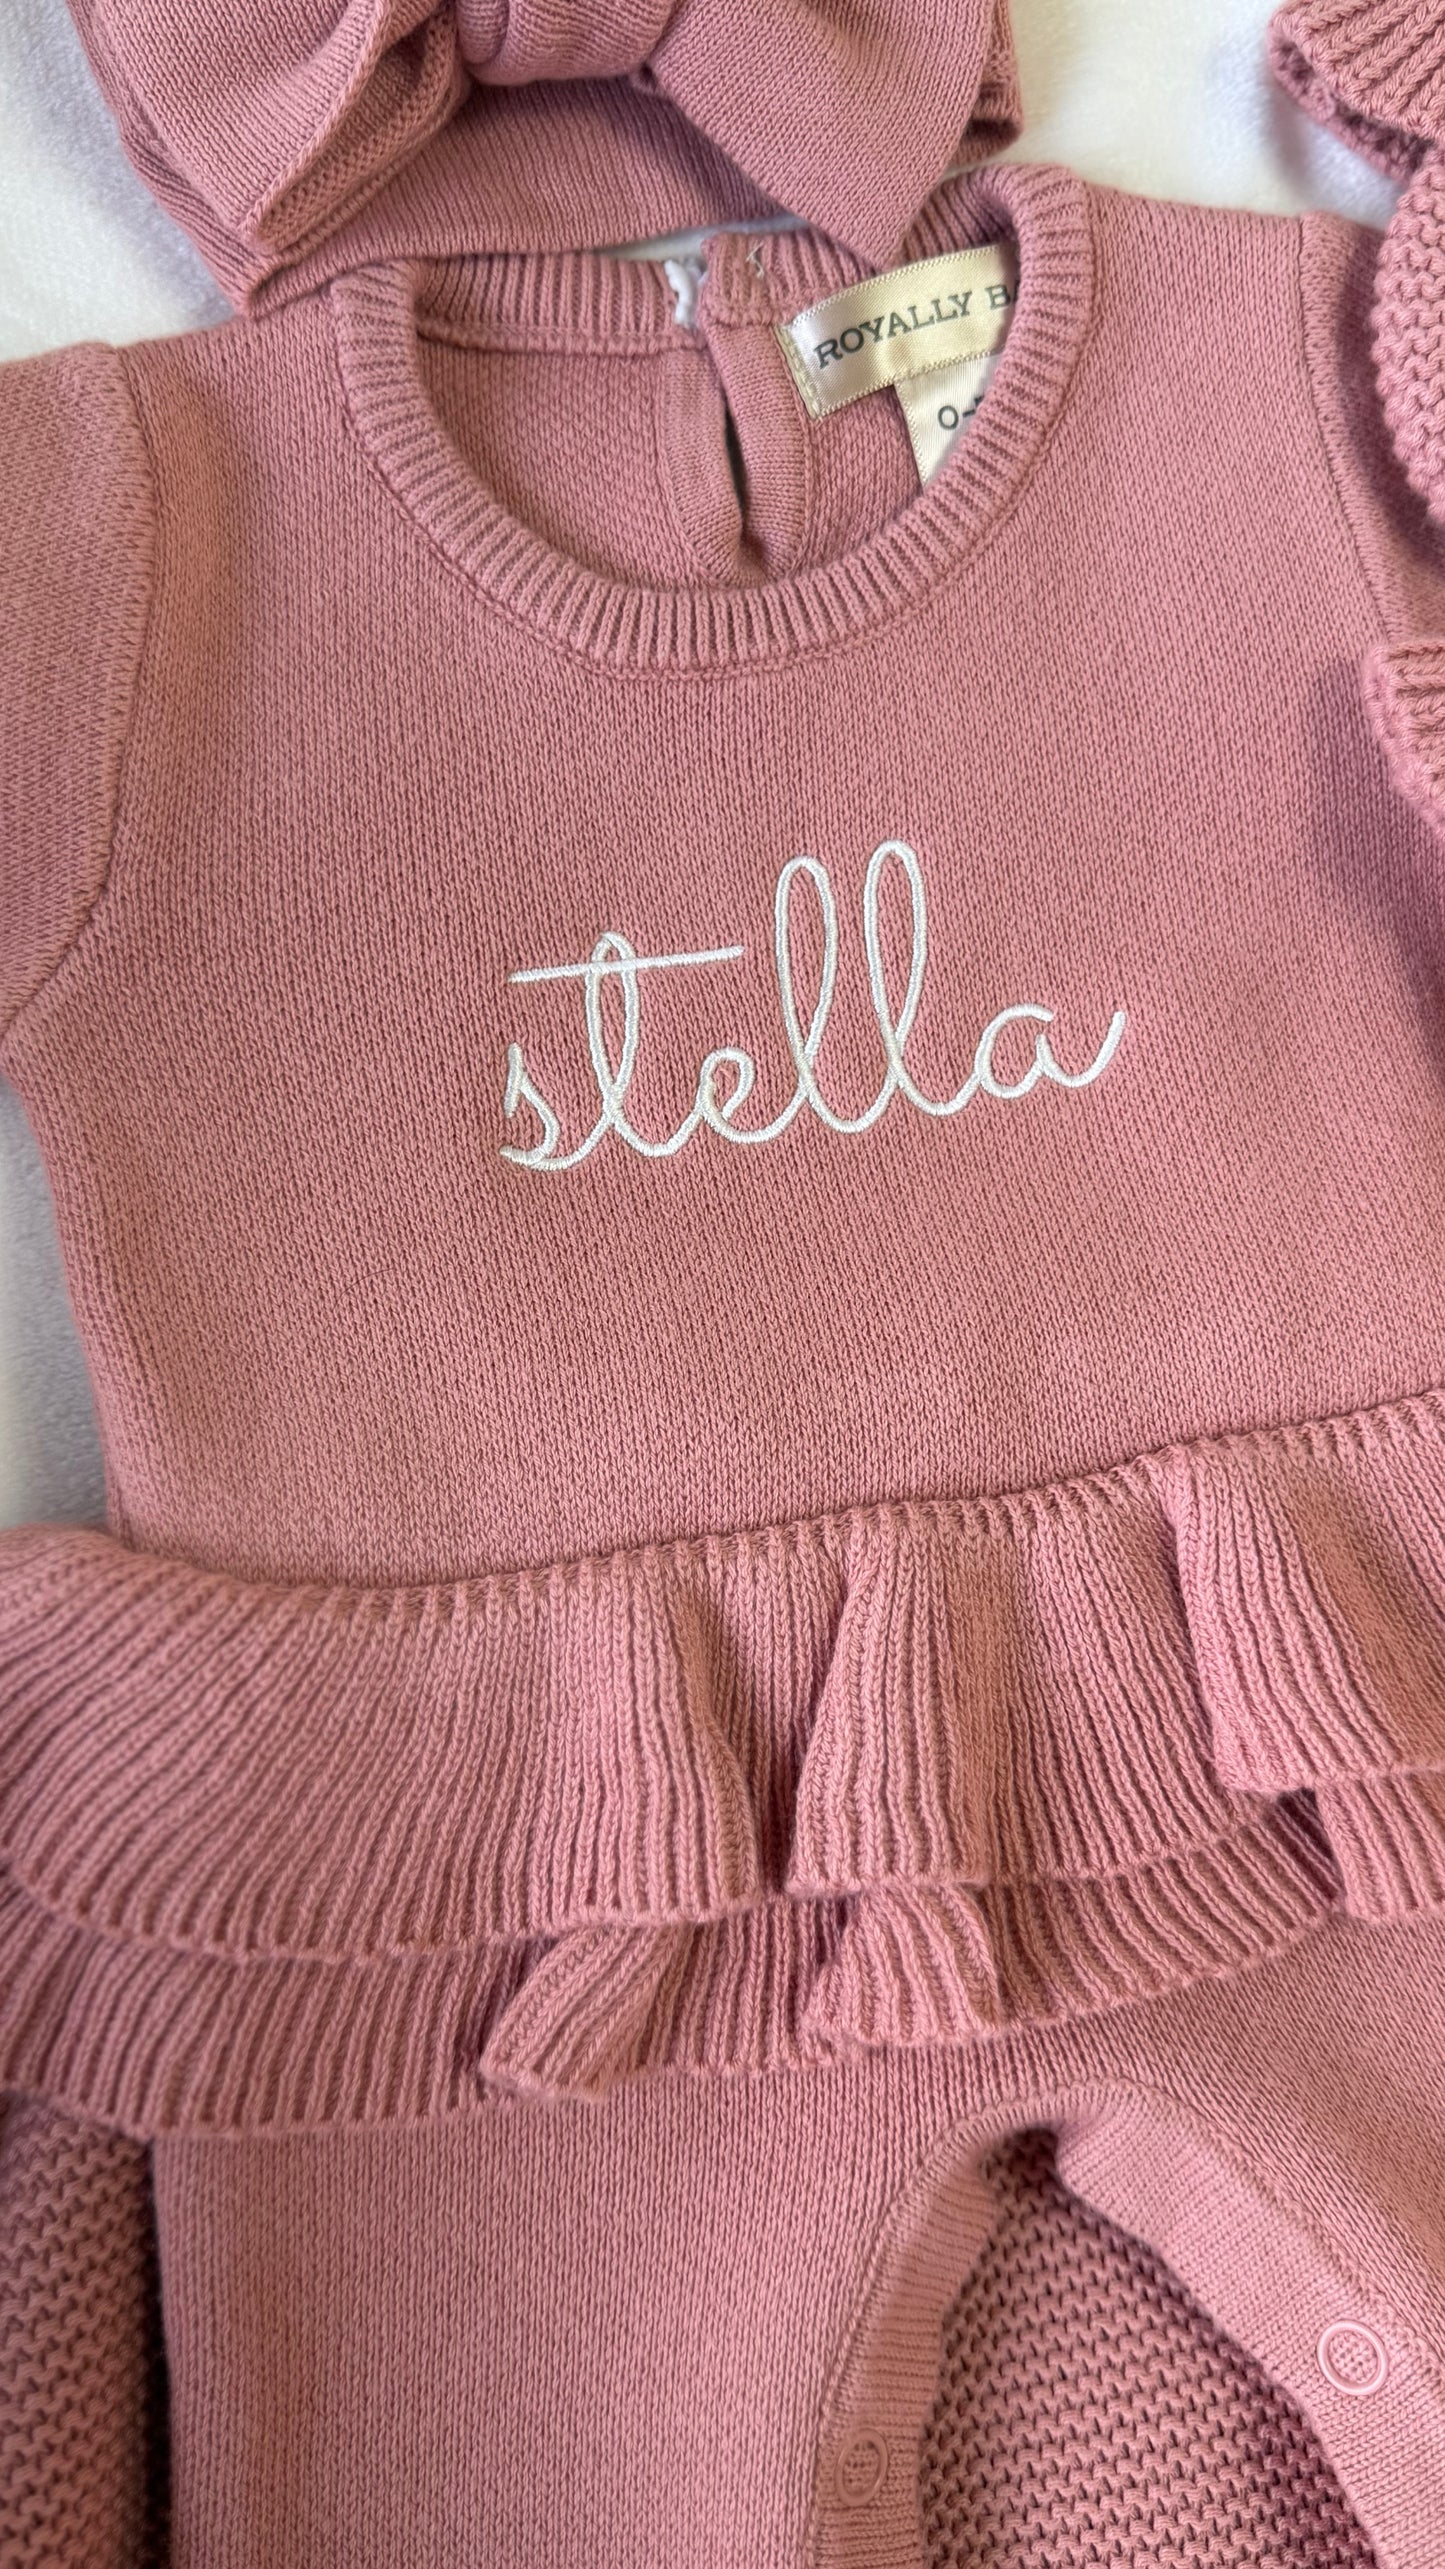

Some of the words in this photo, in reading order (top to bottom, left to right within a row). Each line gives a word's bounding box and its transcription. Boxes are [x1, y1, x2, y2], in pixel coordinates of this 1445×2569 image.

[813, 290, 973, 369] ROYALLY
[985, 284, 1019, 310] B
[937, 395, 985, 431] 0-
[499, 839, 1127, 1171] stella
